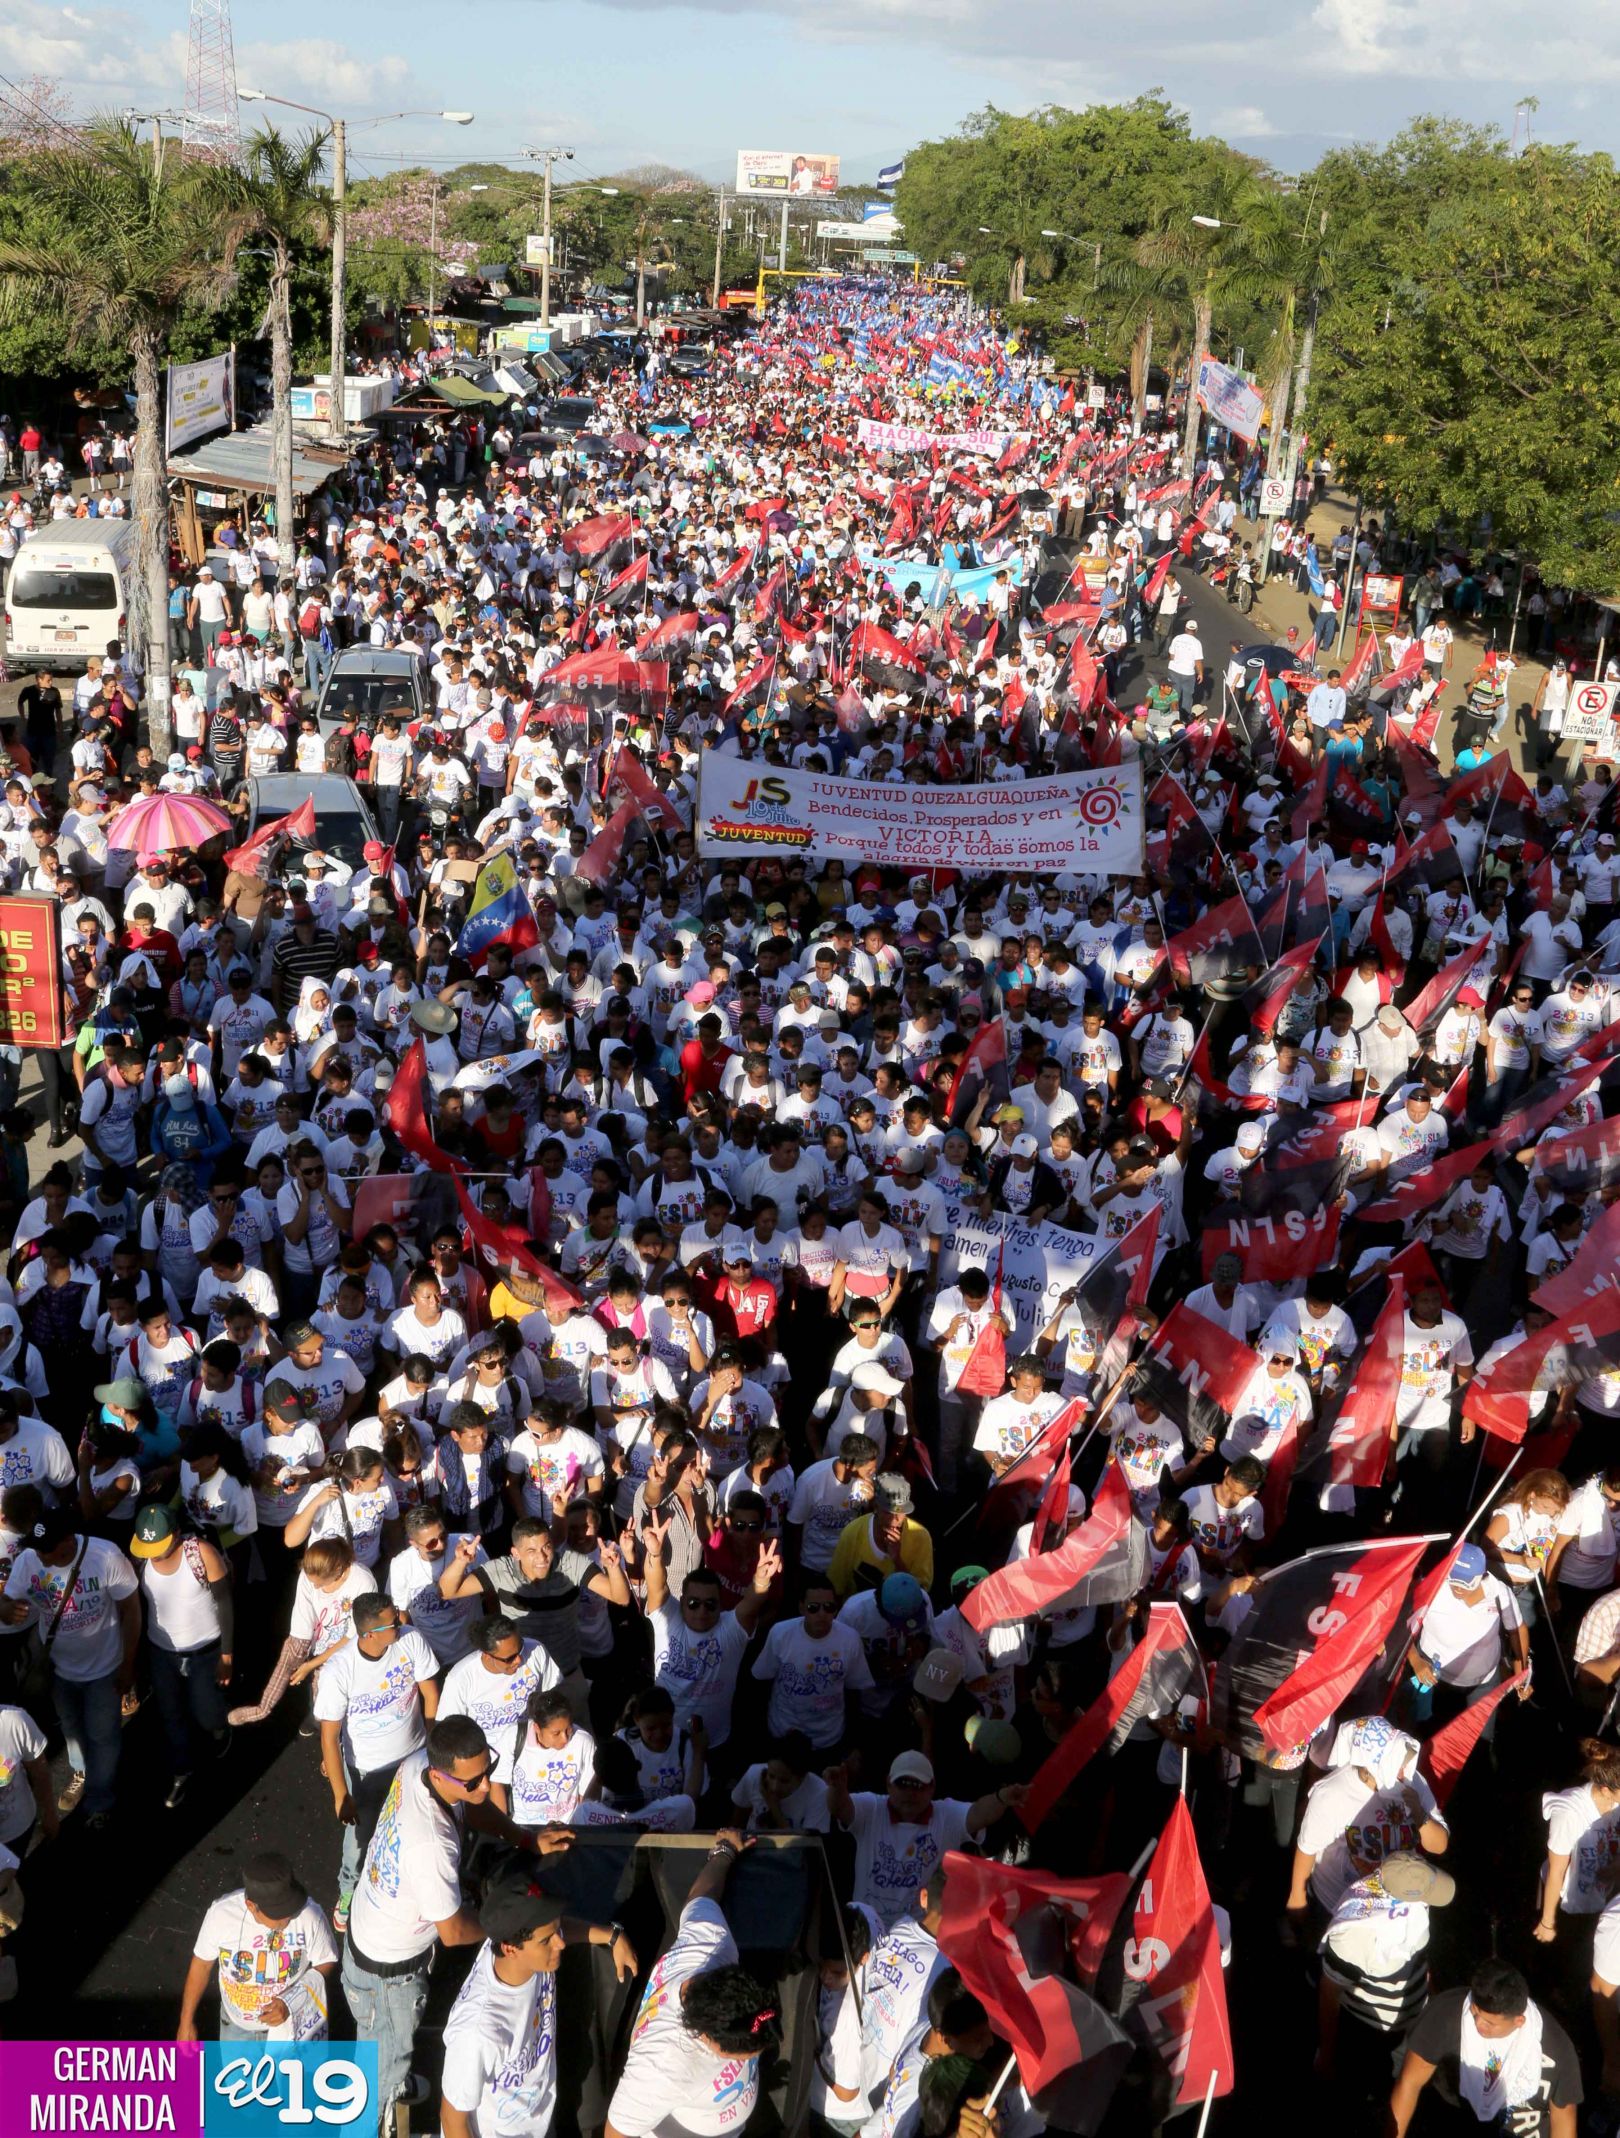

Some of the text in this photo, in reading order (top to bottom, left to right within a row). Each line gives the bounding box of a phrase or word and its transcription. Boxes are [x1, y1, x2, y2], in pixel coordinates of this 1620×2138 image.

[870, 648, 917, 674] FSLN
[1565, 724, 1603, 736] ESTACIONAR
[809, 782, 1070, 806] JUVENTUD QUEZALGUAQUEÑA
[1021, 813, 1035, 827] y
[1038, 806, 1062, 821] en
[719, 826, 807, 845] JUVENTUD
[825, 831, 1100, 858] Porque todos y todas somos la
[1034, 858, 1067, 871] paz
[0, 1010, 37, 1032] 26
[1043, 1228, 1095, 1259] tengo
[925, 1663, 951, 1684] NY
